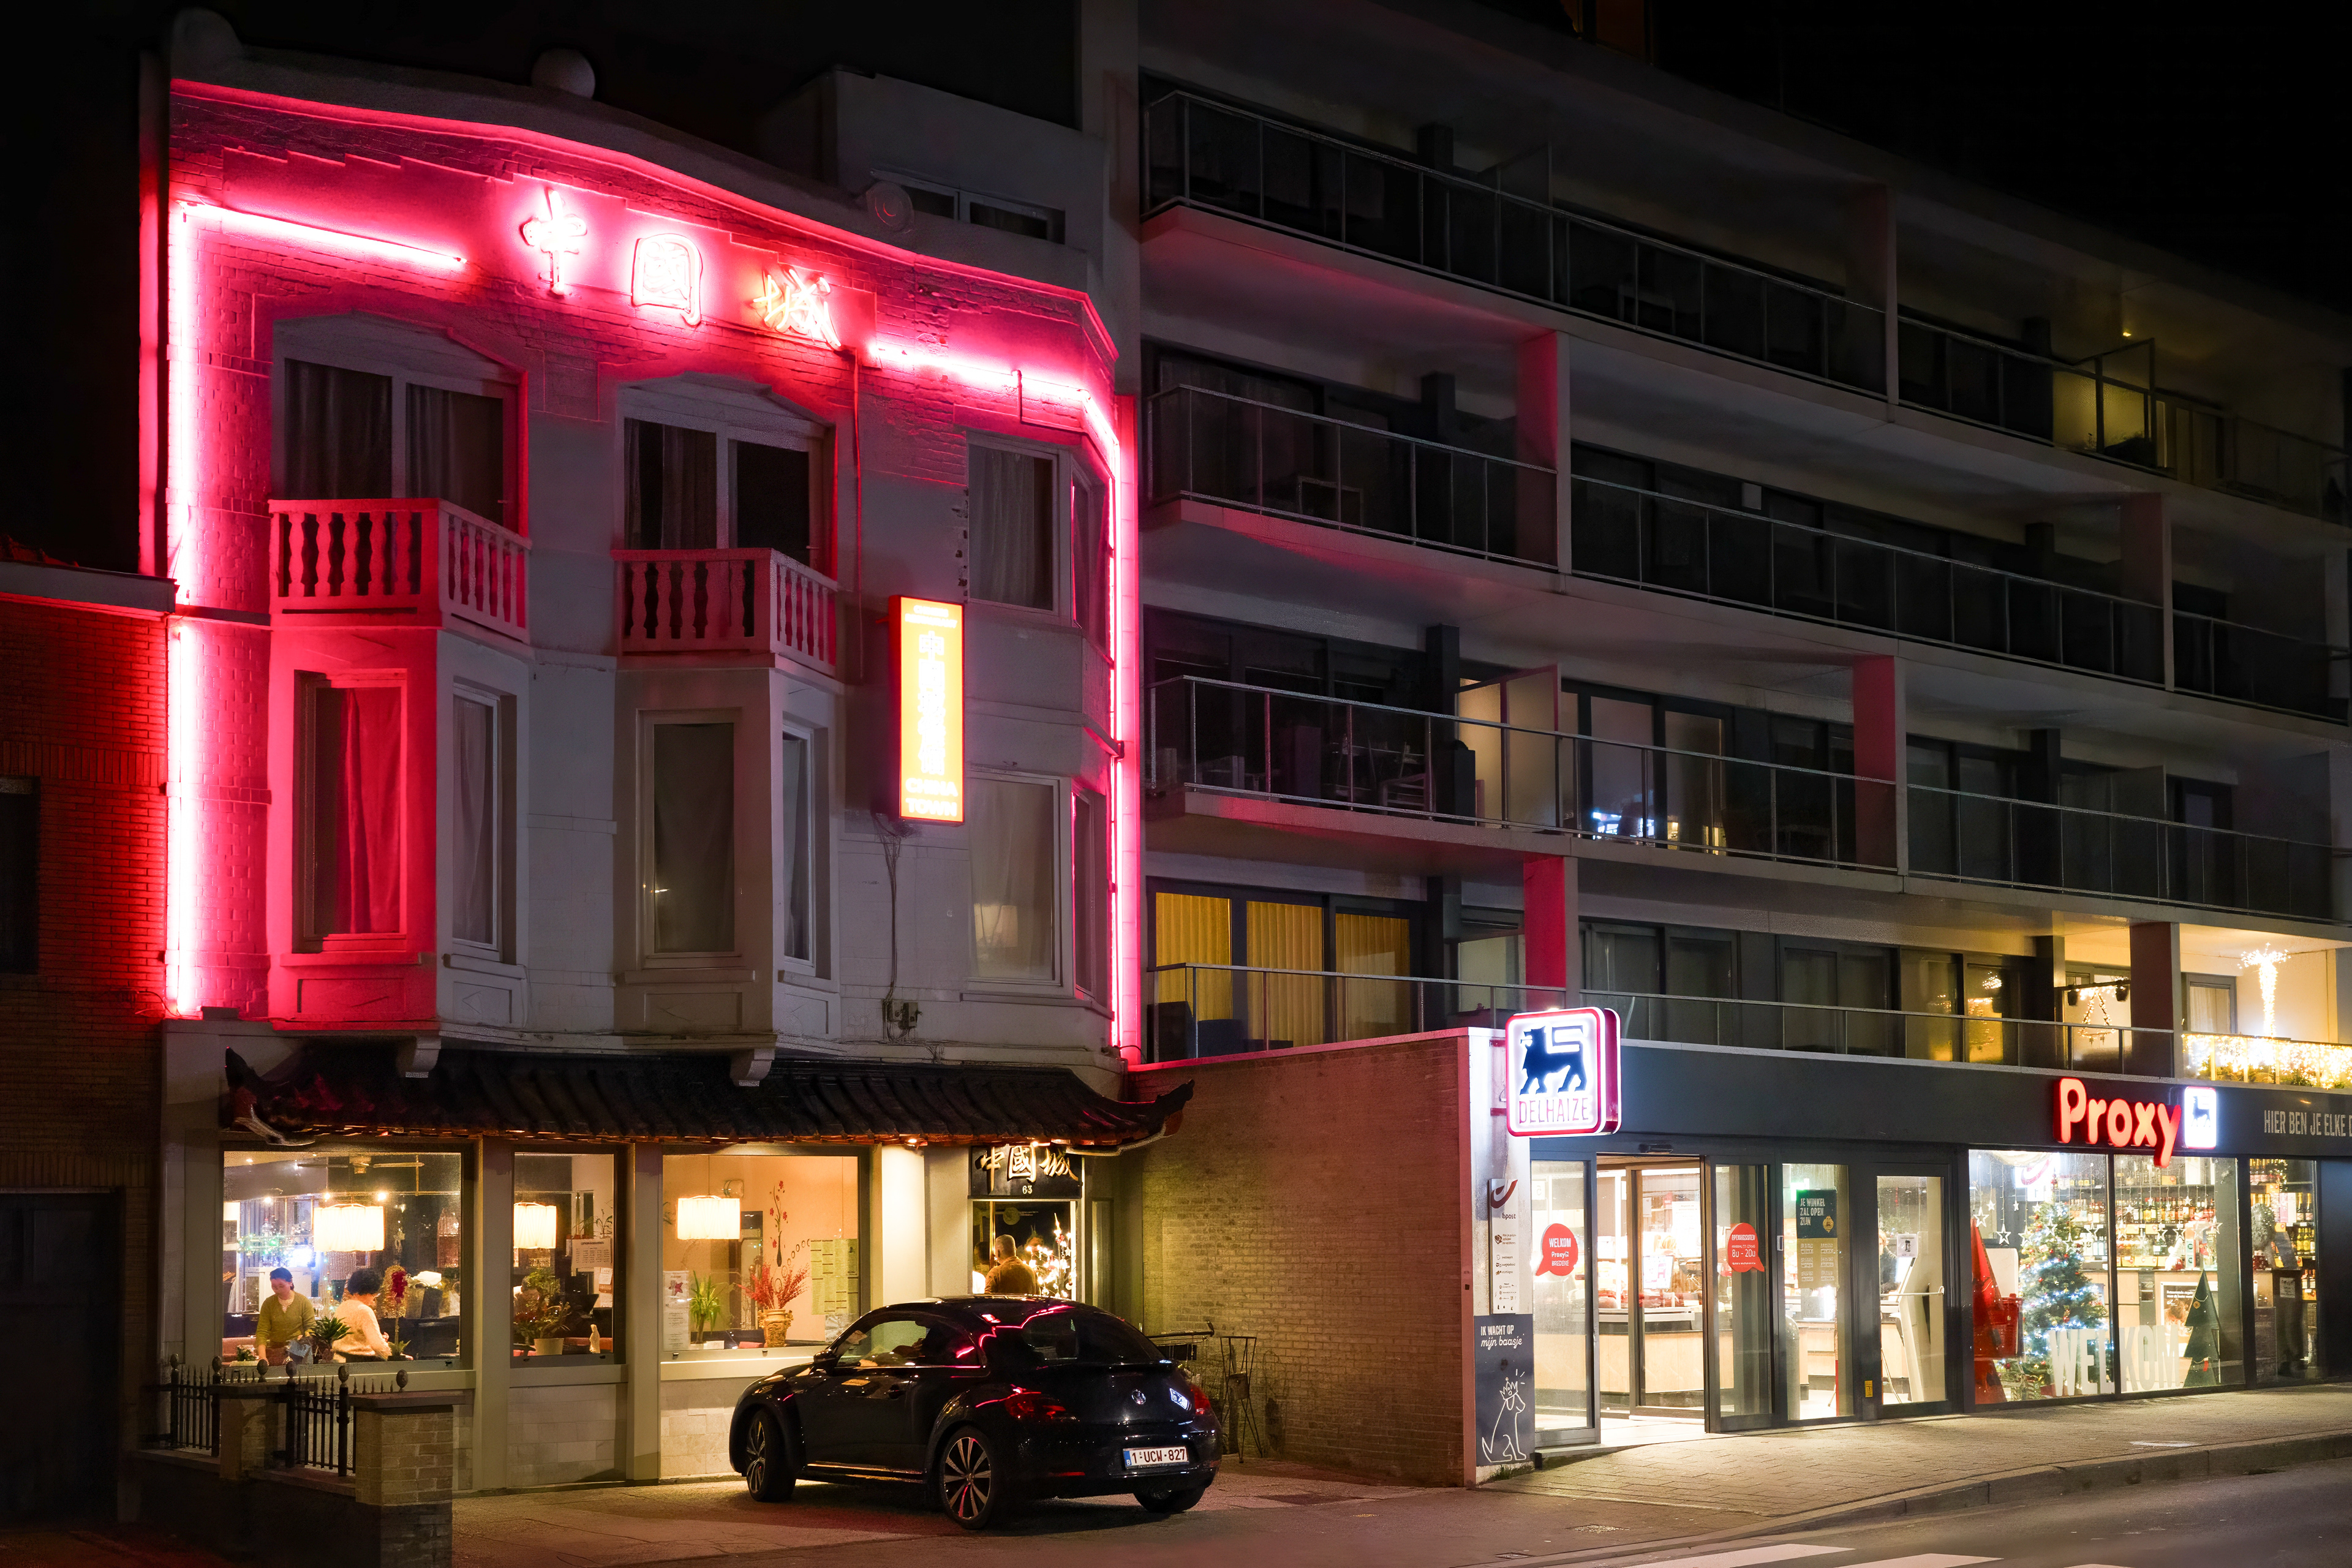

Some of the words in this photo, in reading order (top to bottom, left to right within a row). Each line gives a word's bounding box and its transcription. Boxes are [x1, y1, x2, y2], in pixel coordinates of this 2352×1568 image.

[905, 777, 958, 797] CHINA
[905, 797, 957, 816] TOWN
[1519, 1098, 1589, 1124] DELHAIZE
[2055, 1077, 2182, 1168] Proxy
[2264, 1110, 2286, 1134] HIER
[2289, 1112, 2307, 1135] BEN
[2310, 1113, 2322, 1136] JE
[2324, 1114, 2346, 1137] ELKE
[980, 1143, 1079, 1194] 中國城
[1022, 1185, 1033, 1194] 63
[1807, 1197, 1825, 1207] WINKEL
[1800, 1207, 1809, 1216] ZAL
[1811, 1207, 1824, 1216] OPEN
[1548, 1237, 1572, 1248] WELKOM
[1732, 1249, 1740, 1257] 8u
[1745, 1249, 1756, 1257] 20u
[1480, 1325, 1487, 1336] IK
[1488, 1325, 1506, 1336] WACHT
[1507, 1325, 1514, 1335] OP
[1480, 1336, 1498, 1351] mijn
[1499, 1336, 1523, 1349] baasje
[2048, 1324, 2180, 1397] WELKOM
